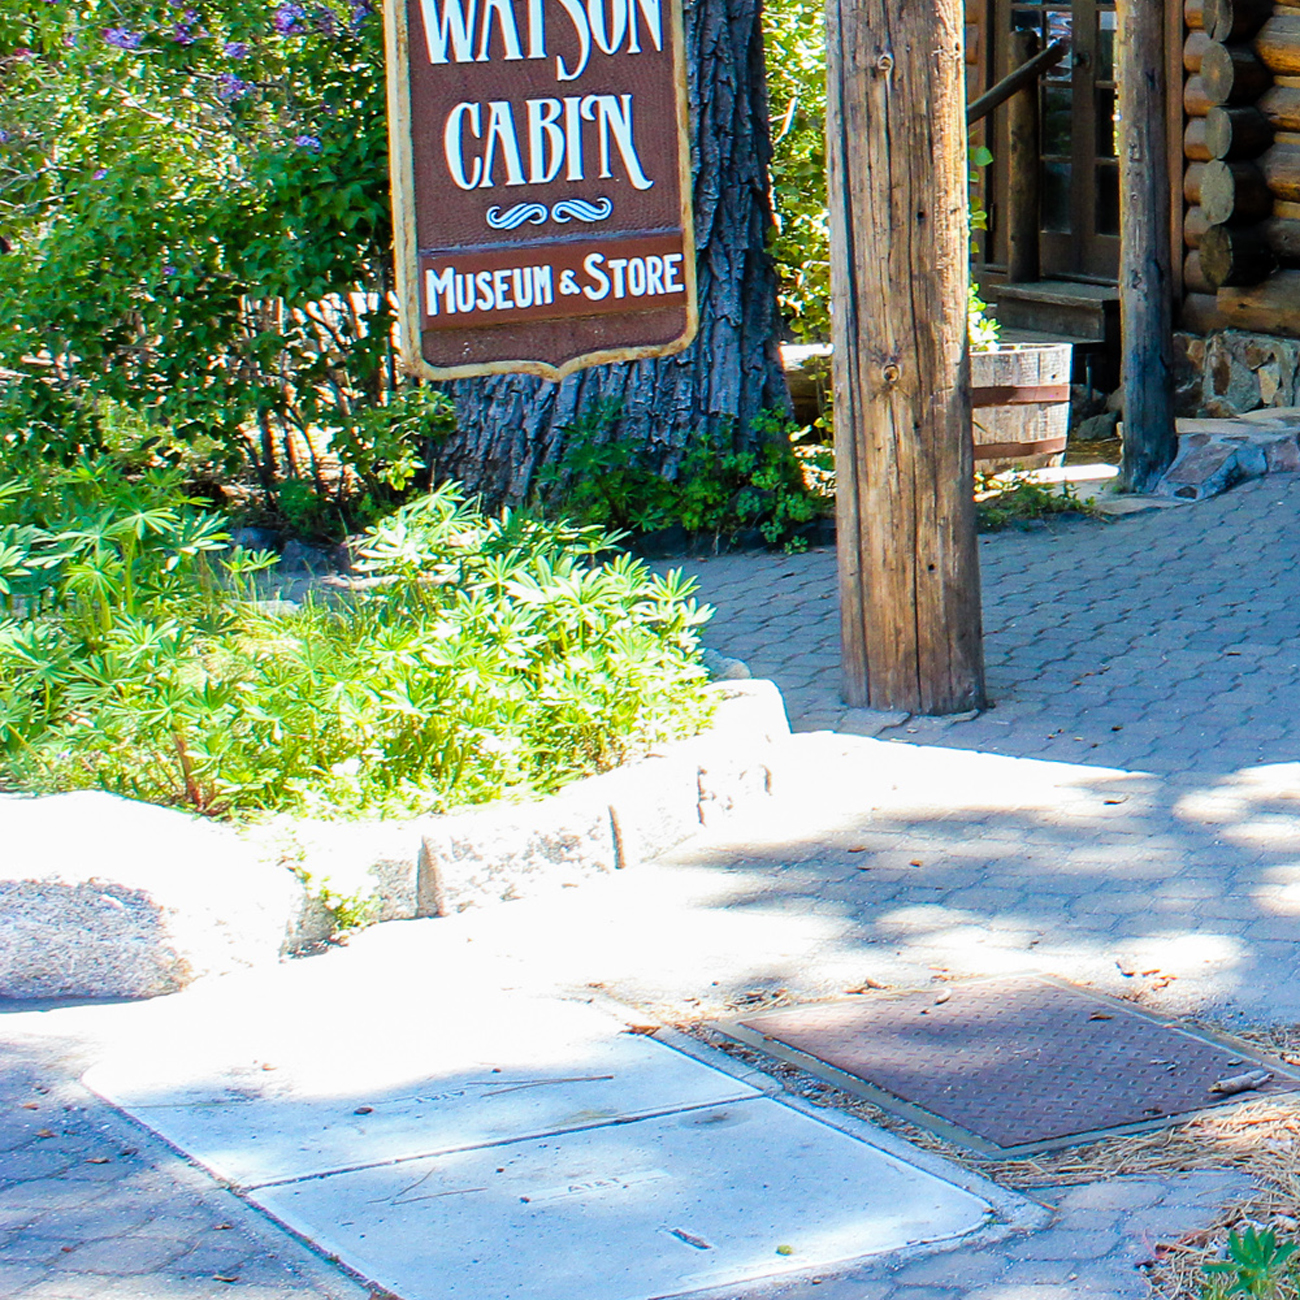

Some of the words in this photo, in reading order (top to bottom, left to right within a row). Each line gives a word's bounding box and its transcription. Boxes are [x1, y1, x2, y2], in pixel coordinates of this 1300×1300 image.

[444, 94, 654, 190] CABIN
[425, 265, 555, 316] MUSEUM
[559, 269, 581, 295] &
[583, 253, 685, 301] STORE
